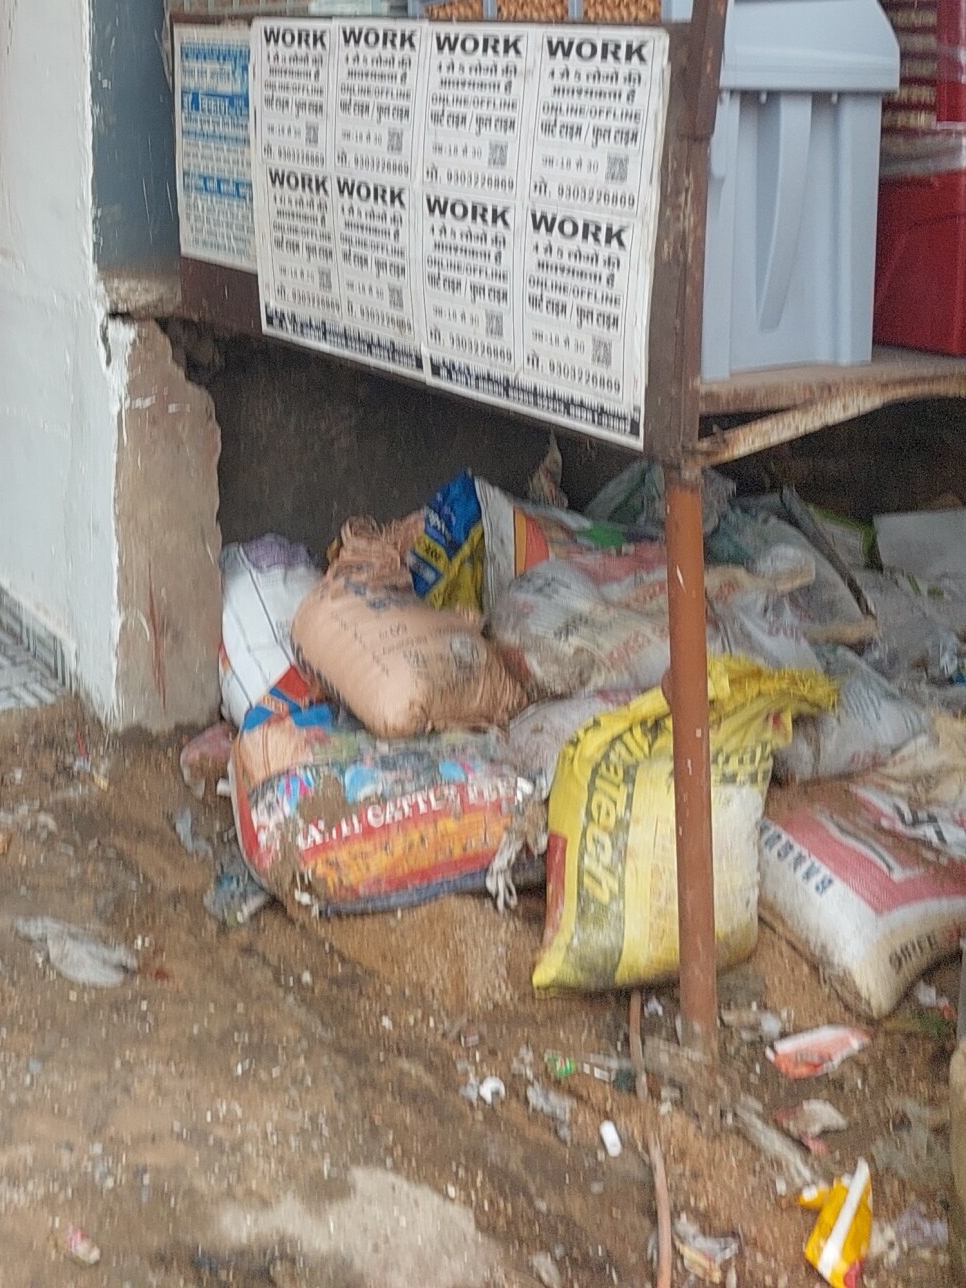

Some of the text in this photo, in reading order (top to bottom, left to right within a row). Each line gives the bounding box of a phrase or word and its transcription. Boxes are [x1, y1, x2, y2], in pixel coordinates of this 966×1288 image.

[263, 27, 326, 50] WORK
[342, 28, 415, 50] WORK
[435, 33, 522, 57] WORK
[547, 37, 647, 64] WORK
[269, 167, 329, 197] WORK
[337, 177, 406, 209] WORK
[426, 195, 510, 229] WORK
[530, 209, 625, 250] WORK
